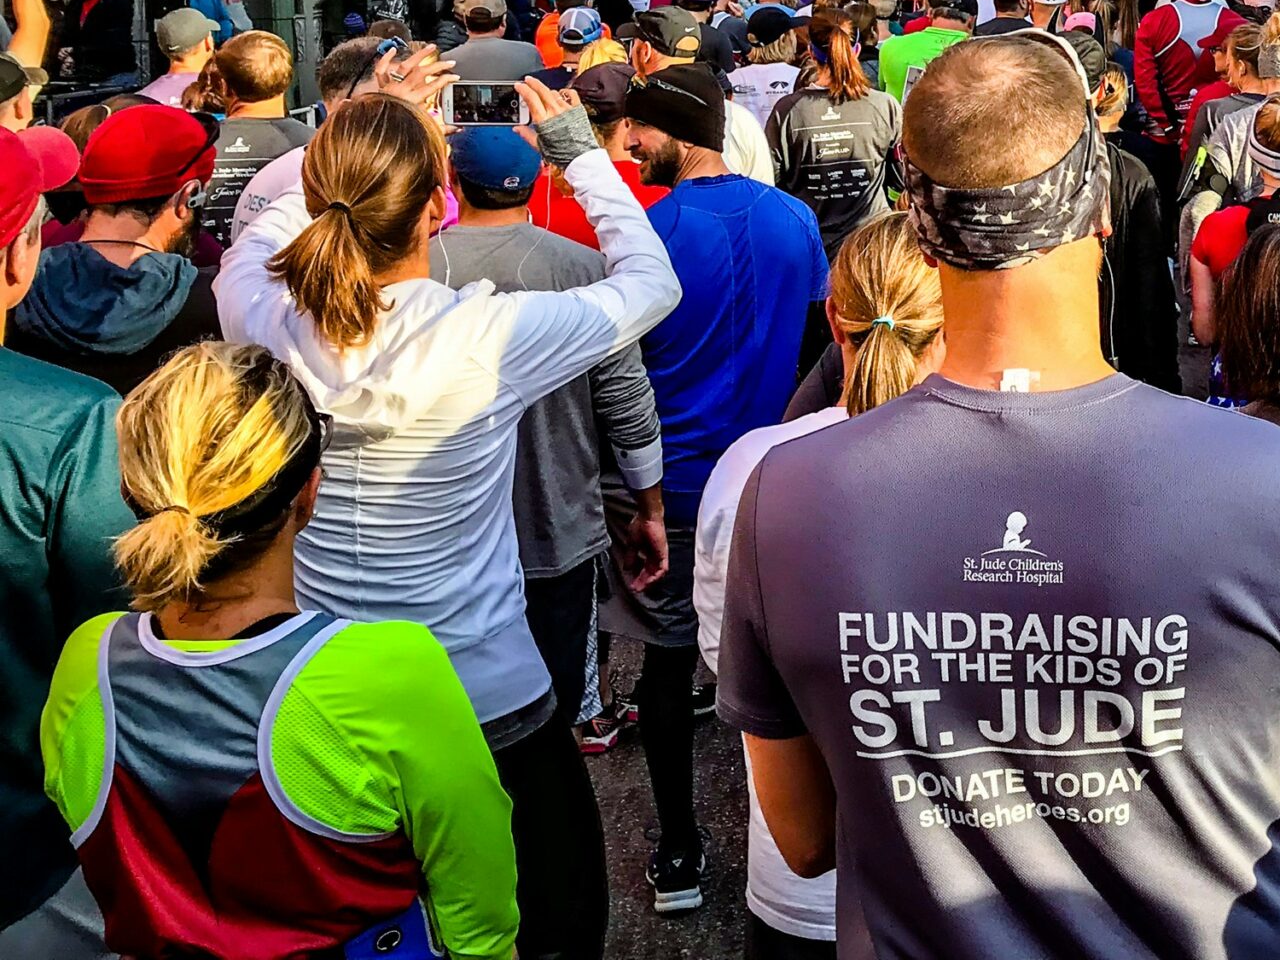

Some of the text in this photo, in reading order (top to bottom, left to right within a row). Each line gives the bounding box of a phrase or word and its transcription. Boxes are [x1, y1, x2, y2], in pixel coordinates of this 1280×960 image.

[963, 557, 1064, 571] St. Jude Children's
[963, 570, 1063, 587] Research Hospital
[838, 612, 1188, 656] FUNDRAISING
[840, 652, 1188, 686] FOR THE KIDS OF
[849, 687, 1186, 748] ST. JUDE
[891, 767, 1150, 803] DONATE TODAY
[918, 801, 1131, 829] stjudeheroes.org
